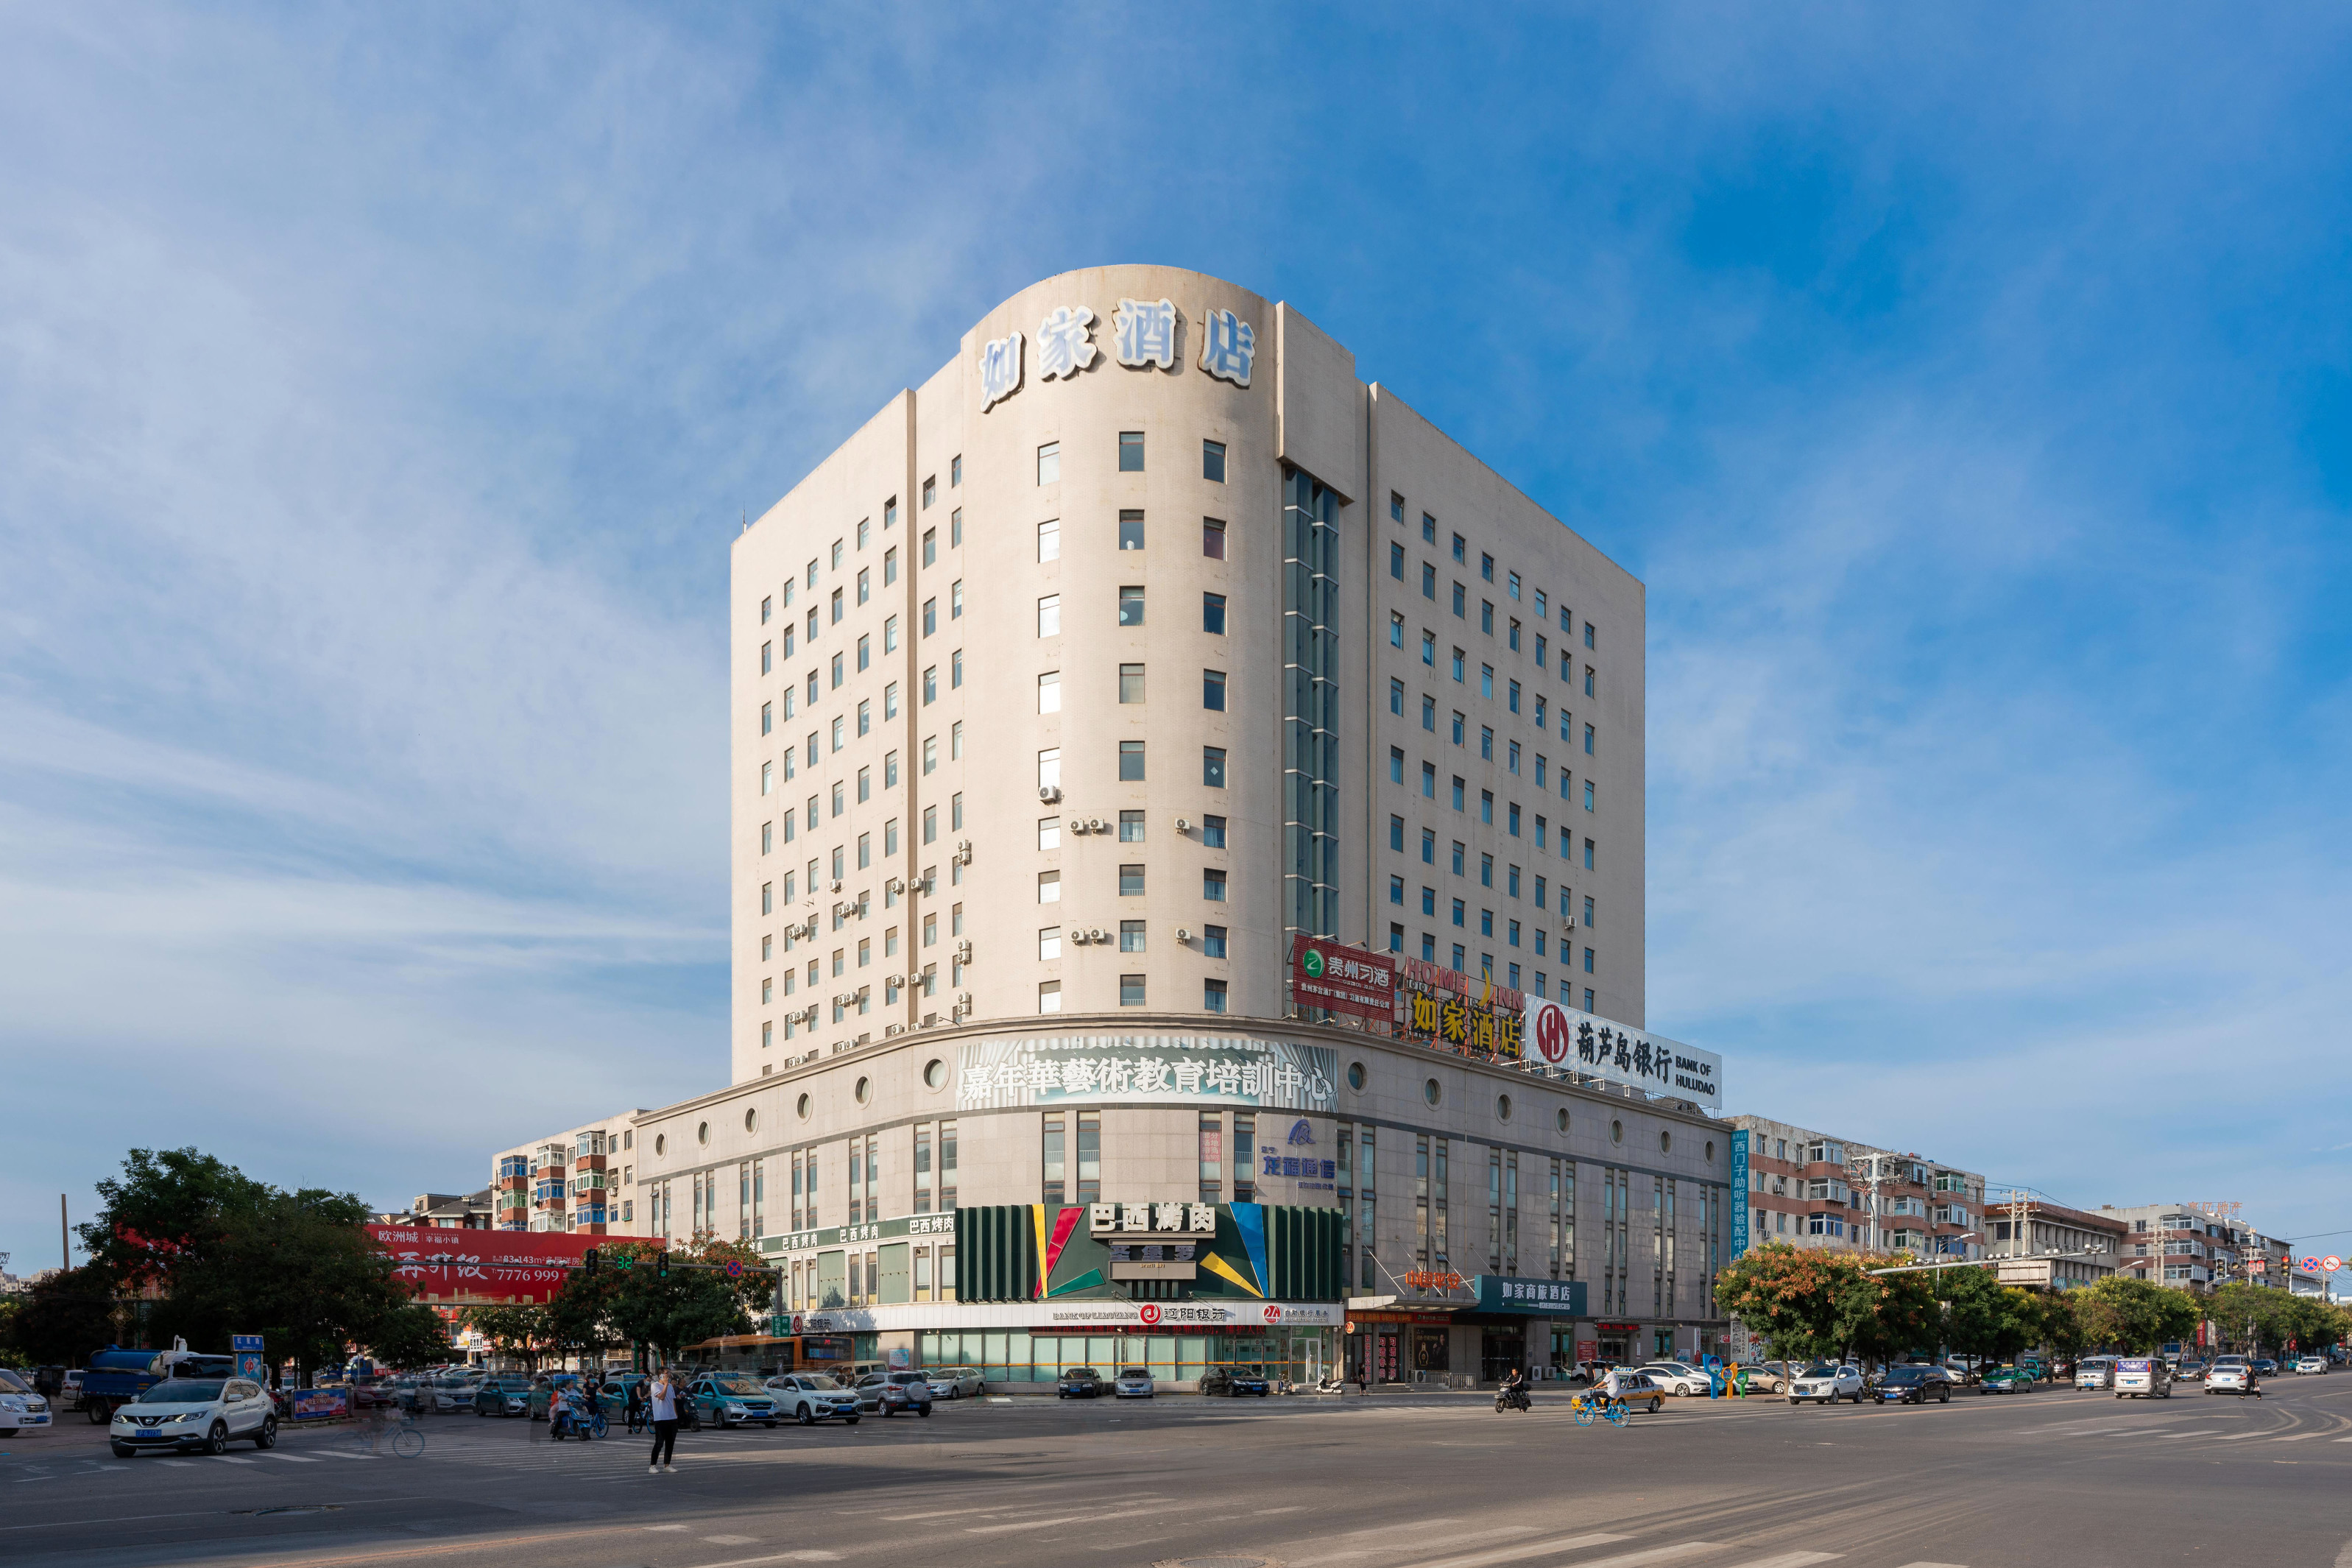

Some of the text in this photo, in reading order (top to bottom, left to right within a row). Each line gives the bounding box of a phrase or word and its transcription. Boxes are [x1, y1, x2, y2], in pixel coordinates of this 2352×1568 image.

[980, 297, 1256, 414] 如家酒店
[1329, 956, 1389, 987] 贵州习酒
[1406, 956, 1467, 994] HOME
[1349, 994, 1390, 1009] 习酒有限责任公司
[1413, 991, 1521, 1056] 如家酒店
[1577, 1021, 1673, 1084] 葫芦岛银行
[1675, 1056, 1712, 1076] BANK OF
[962, 1056, 1333, 1101] 嘉年華藝術教育培訓中心
[1675, 1074, 1715, 1095] HULUDAO
[909, 1215, 955, 1235] 巴西烤肉
[1090, 1202, 1215, 1232] 巴西烤肉
[378, 1230, 419, 1243] 欧洲城
[425, 1235, 459, 1245] 幸福小镇
[783, 1232, 818, 1250] 巴西烤肉
[840, 1223, 880, 1243] 巴西烤肉
[618, 1256, 633, 1269] 32
[1109, 1246, 1196, 1261] 圣堡罗
[534, 1270, 559, 1282] 999
[1405, 1270, 1461, 1289] 中国平安
[1502, 1282, 1570, 1301] 如家商旅酒店
[1092, 1312, 1138, 1320] LIAOYANG
[1164, 1307, 1226, 1321] 辽阳银行
